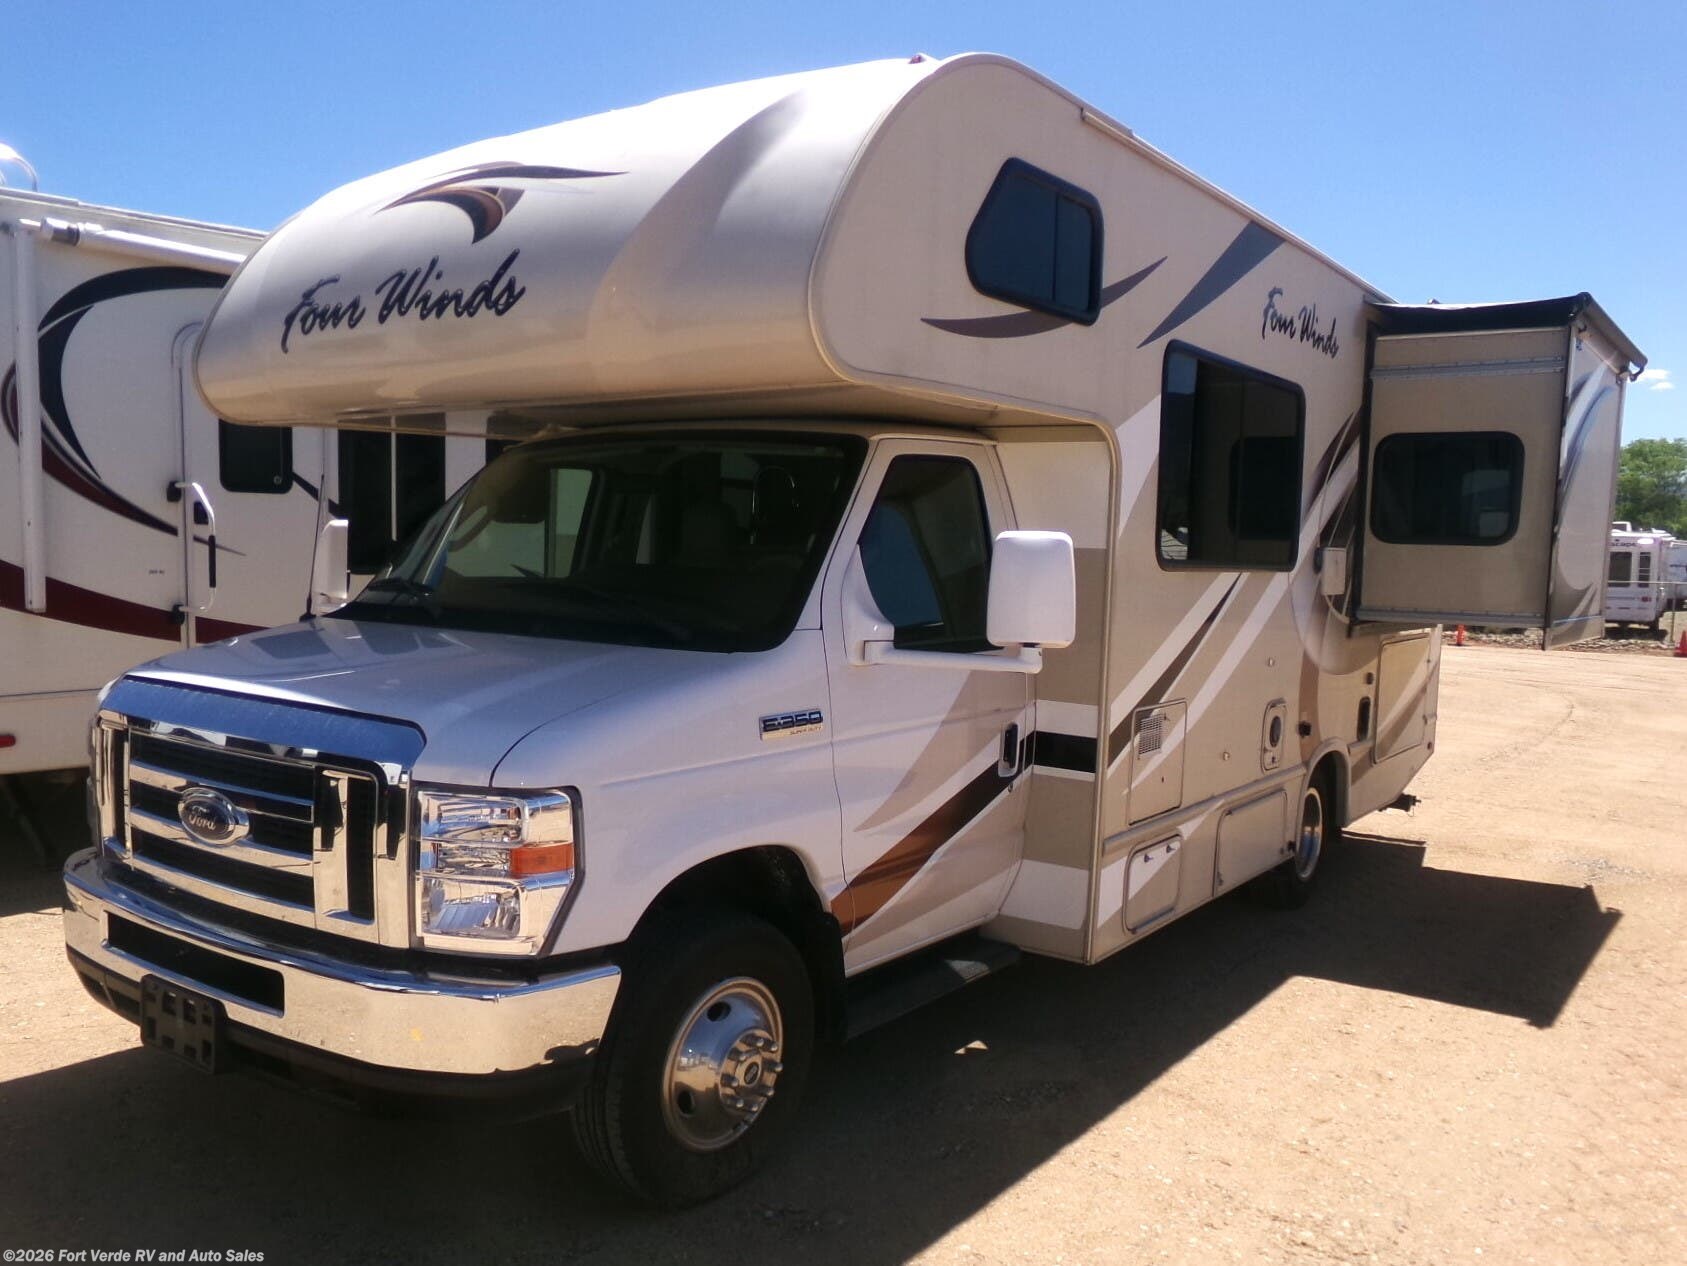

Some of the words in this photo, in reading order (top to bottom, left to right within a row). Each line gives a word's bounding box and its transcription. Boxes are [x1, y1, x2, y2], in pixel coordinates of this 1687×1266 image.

[281, 273, 366, 354] Four
[375, 248, 526, 325] Winds
[1262, 287, 1297, 340] Four
[1299, 303, 1339, 359] Winds
[188, 805, 217, 831] Ford
